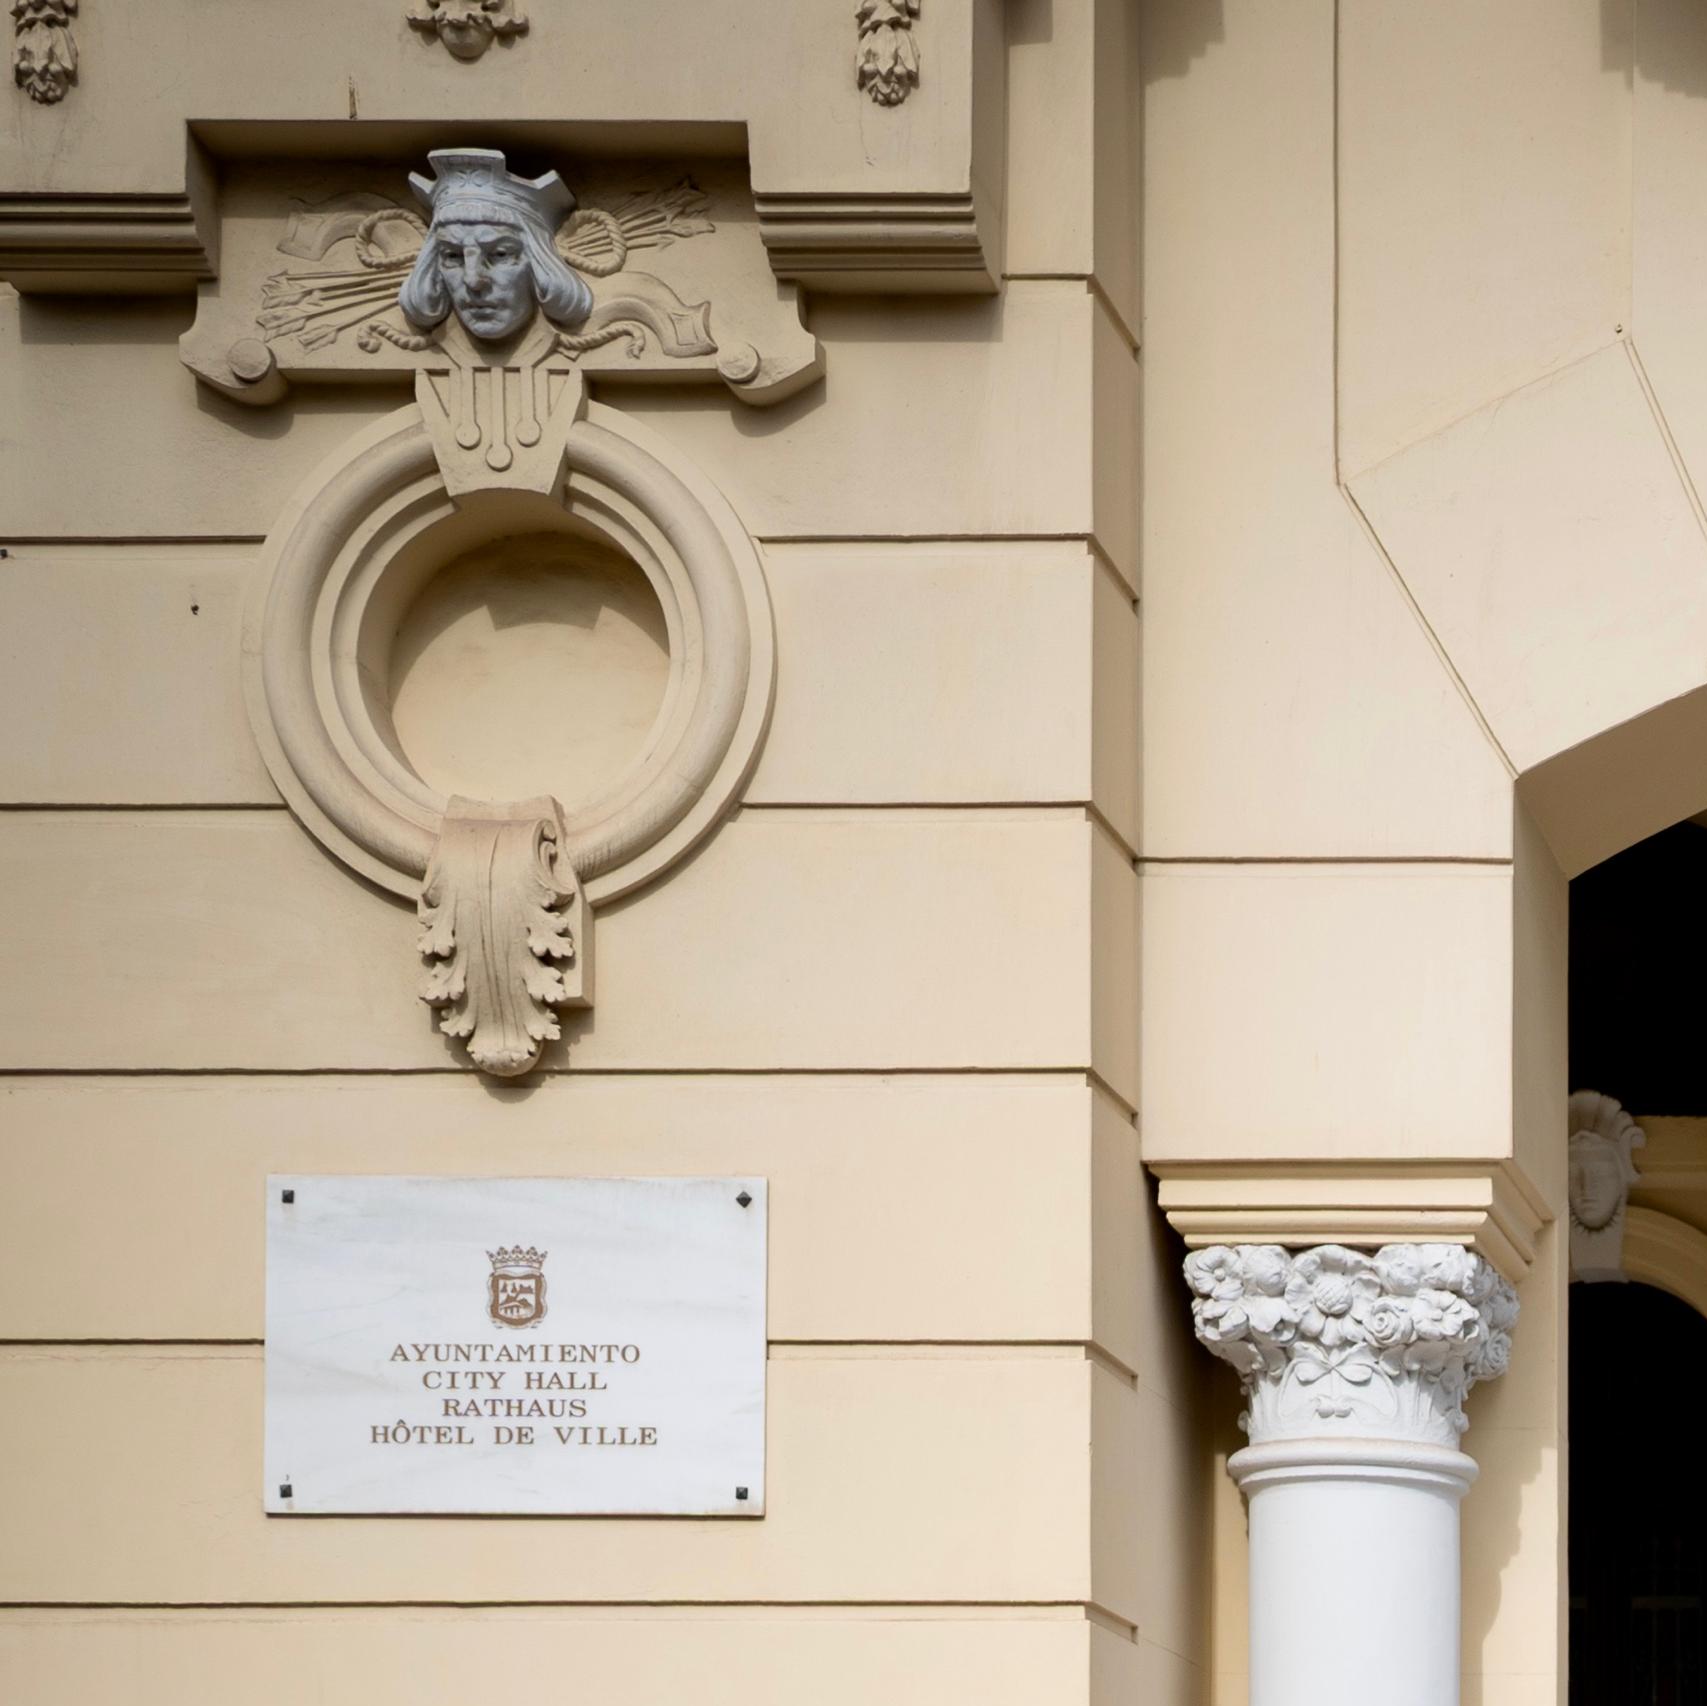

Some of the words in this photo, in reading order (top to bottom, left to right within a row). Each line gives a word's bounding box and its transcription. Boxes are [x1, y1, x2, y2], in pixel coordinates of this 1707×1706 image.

[389, 1343, 640, 1364] AYUNTAMIENTO
[422, 1371, 506, 1390] CITY
[524, 1371, 607, 1392] HALL
[442, 1398, 587, 1418] RATHAUS
[370, 1419, 474, 1445] HÔTEL
[493, 1426, 535, 1445] DE
[554, 1426, 658, 1446] VILLE
